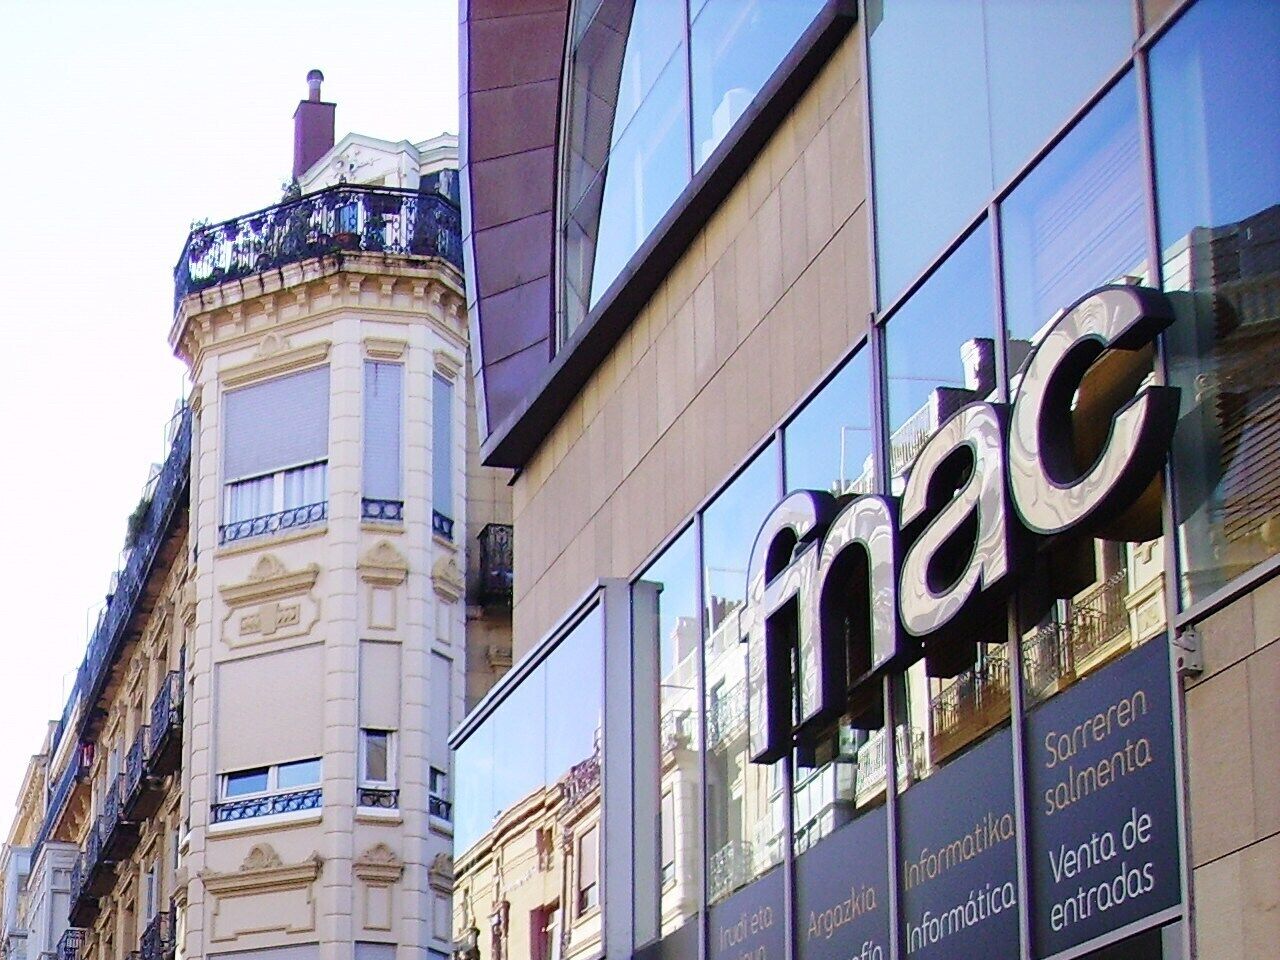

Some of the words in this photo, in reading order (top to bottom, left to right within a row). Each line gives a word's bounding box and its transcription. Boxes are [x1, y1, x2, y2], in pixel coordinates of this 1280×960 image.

[746, 284, 1181, 765] fnac
[1045, 690, 1148, 769] Sarreren
[1045, 738, 1153, 816] salmenta
[904, 812, 1015, 891] Informatika
[1049, 831, 1117, 884] Venta
[1122, 807, 1152, 851] de
[750, 905, 774, 936] eta
[807, 884, 878, 941] Argazkia
[906, 881, 1017, 955] Informática
[1051, 862, 1154, 932] entradas
